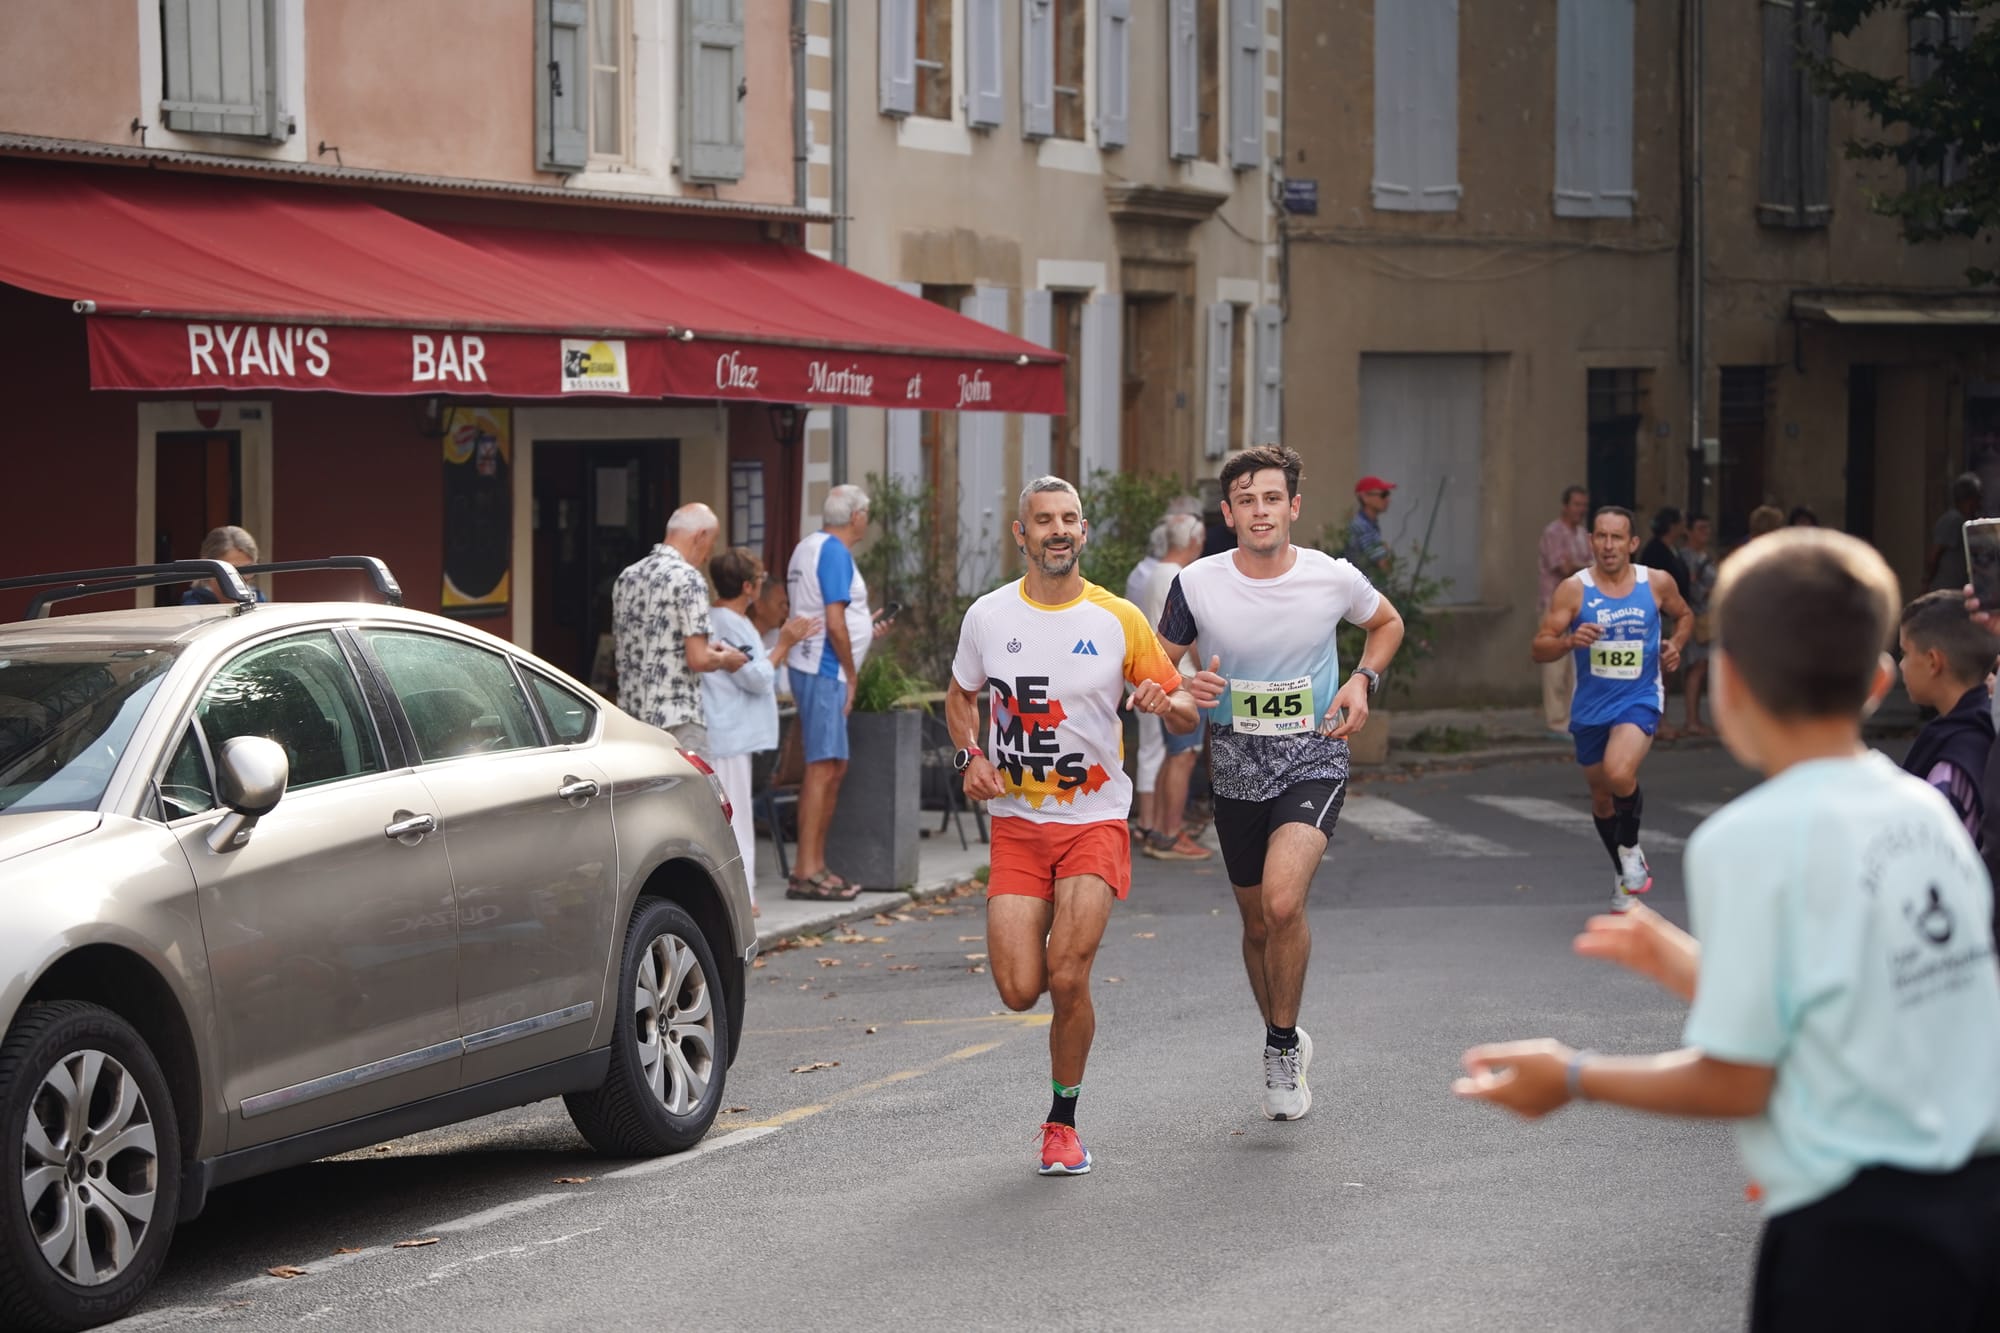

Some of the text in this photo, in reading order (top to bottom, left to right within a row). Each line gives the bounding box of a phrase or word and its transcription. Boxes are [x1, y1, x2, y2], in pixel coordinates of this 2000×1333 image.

[188, 325, 488, 382] RYAN'S BAR
[717, 351, 991, 407] Chez Martine et John
[1598, 651, 1635, 666] 182
[988, 676, 1049, 714] DE
[1243, 694, 1303, 718] 145
[996, 715, 1060, 753] ME
